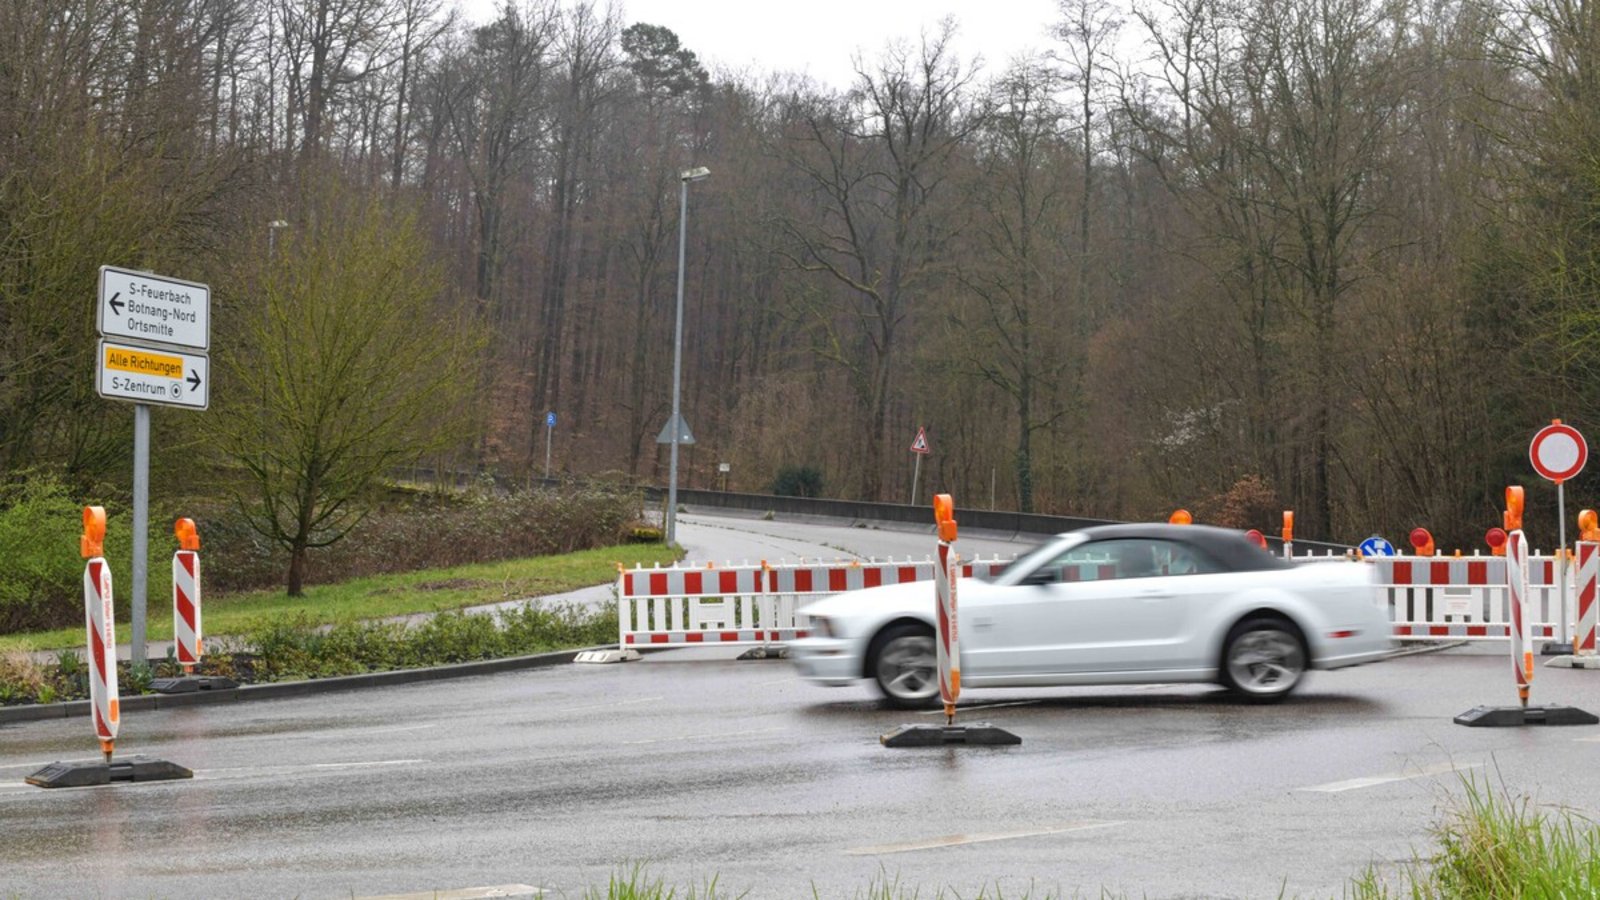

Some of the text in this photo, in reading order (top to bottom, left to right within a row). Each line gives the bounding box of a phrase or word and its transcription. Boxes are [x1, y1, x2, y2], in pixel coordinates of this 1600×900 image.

[129, 282, 191, 305] S-Feuerbach
[128, 300, 196, 323] Botnang-Nord
[128, 318, 174, 336] Ortsmitte
[109, 353, 181, 375] Alle Richtungen
[112, 377, 166, 395] S-Zentrum
